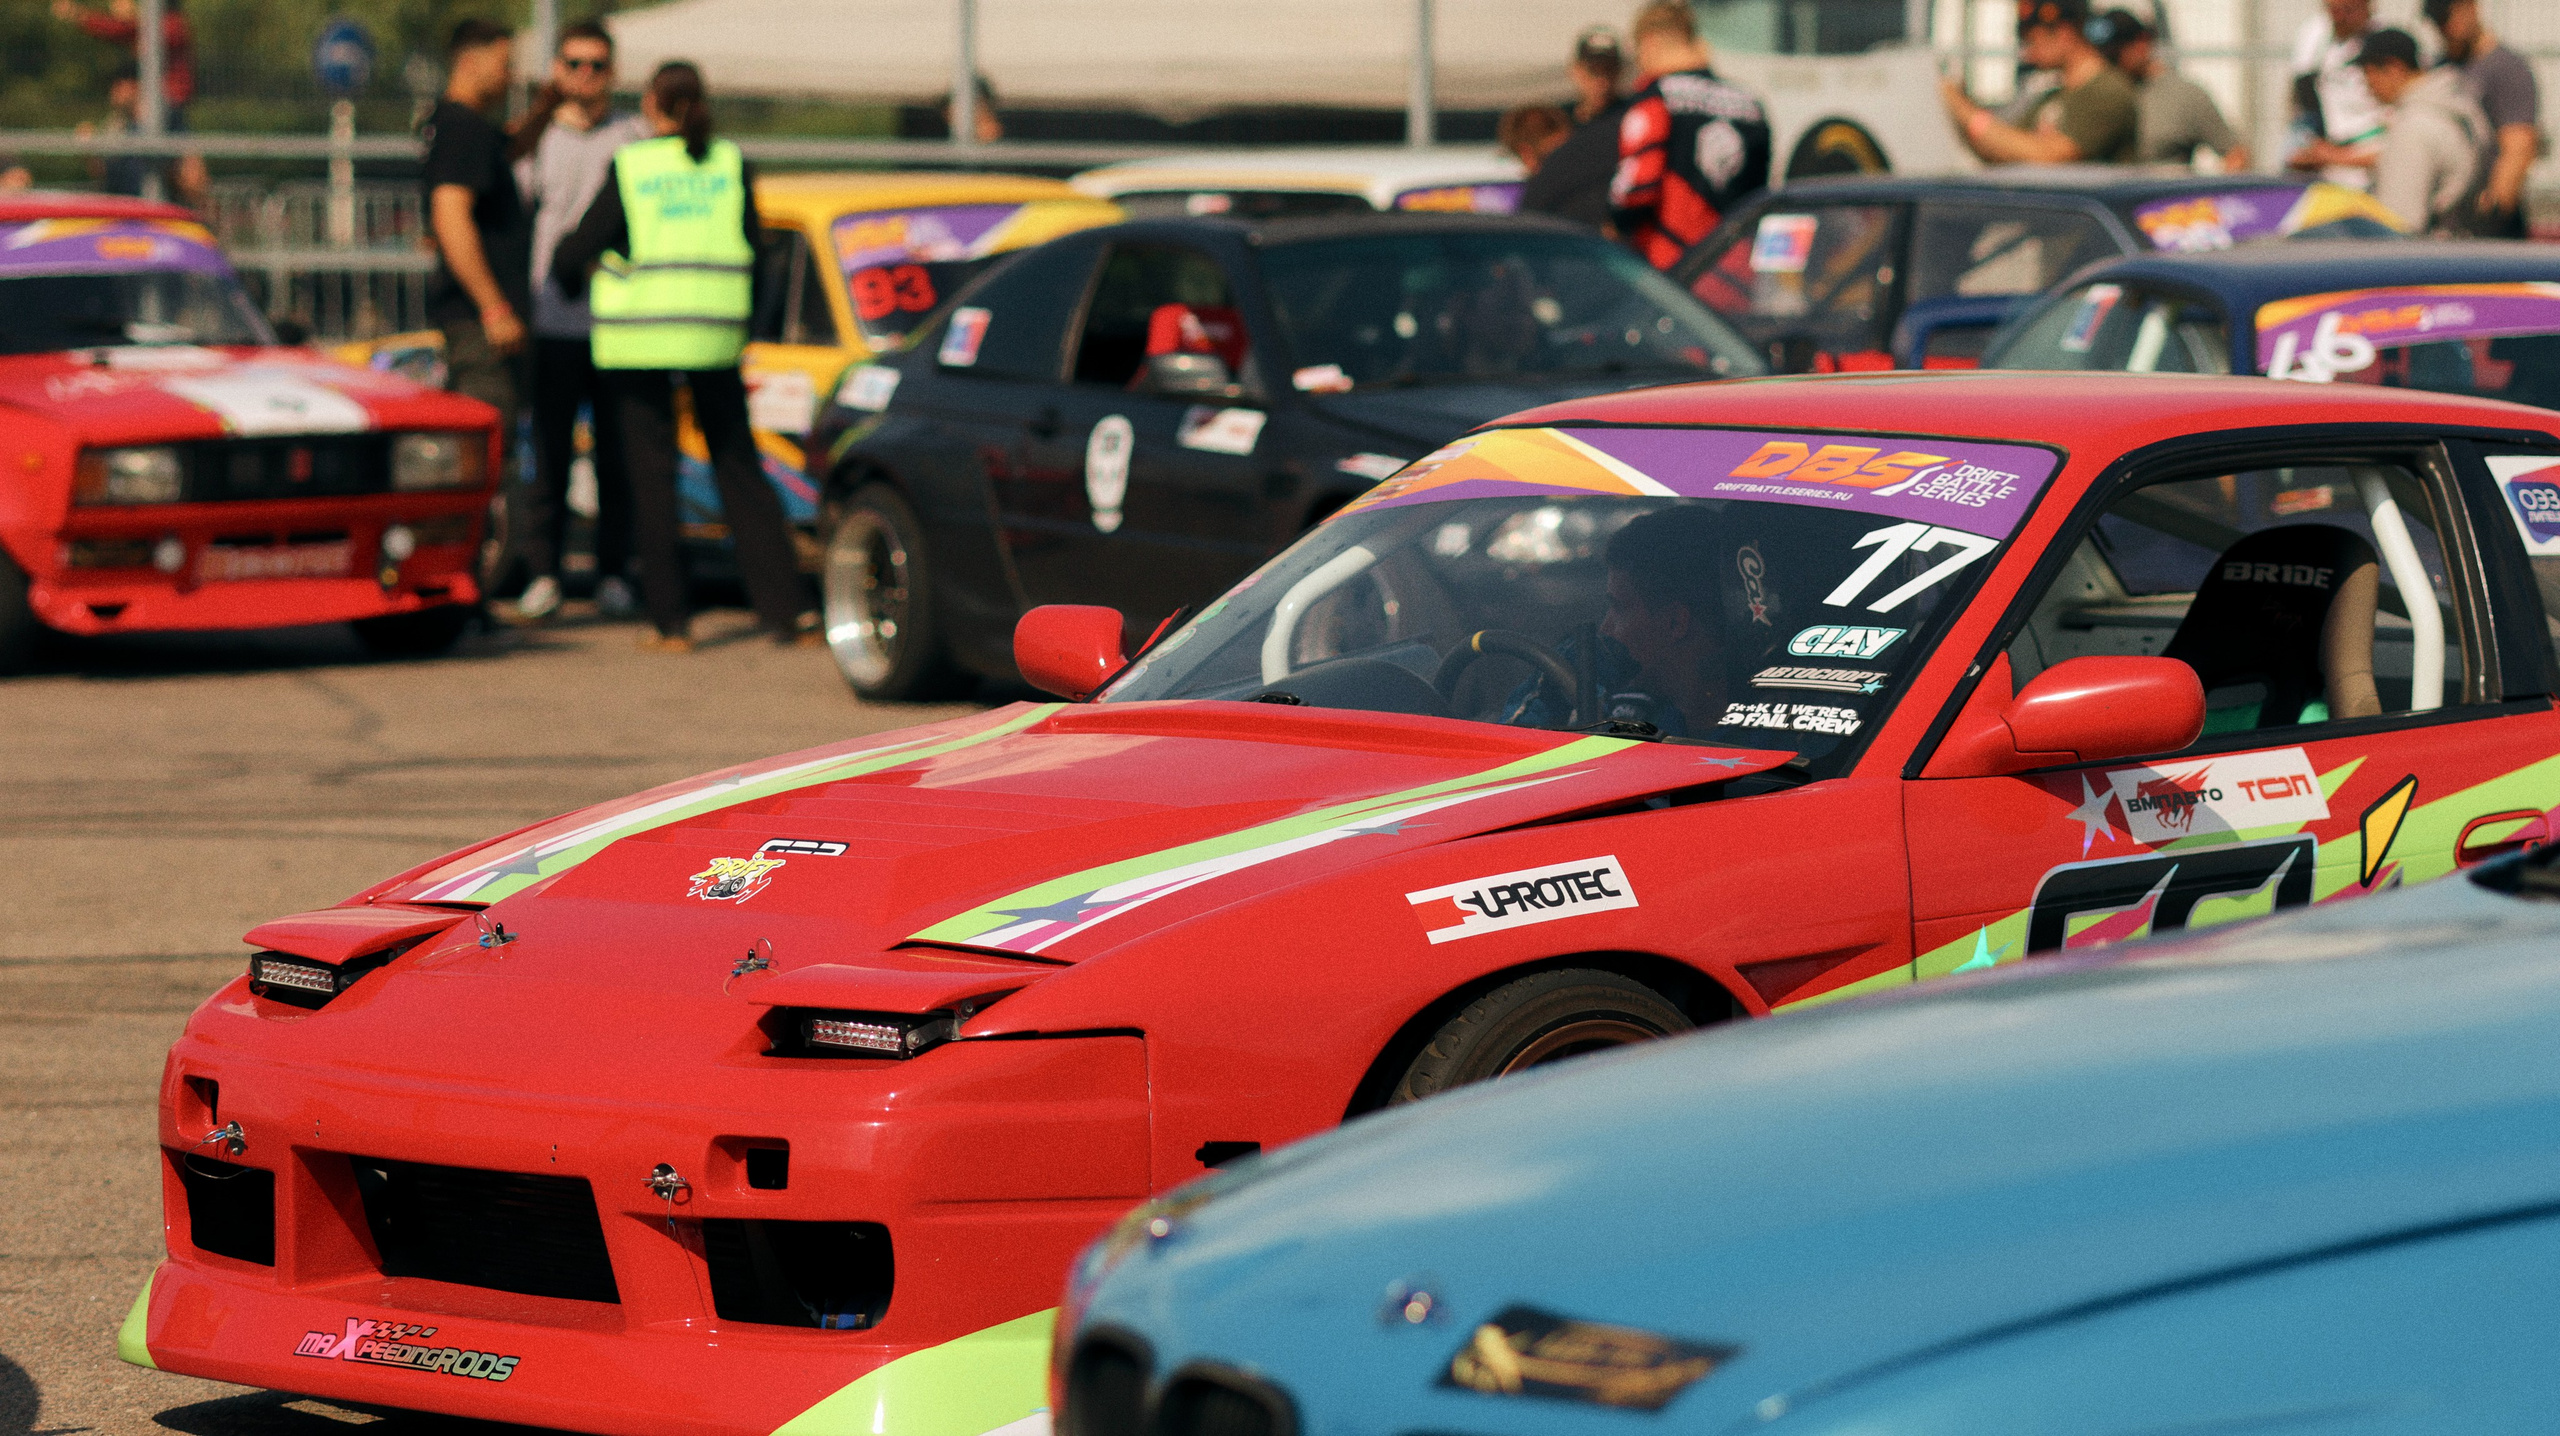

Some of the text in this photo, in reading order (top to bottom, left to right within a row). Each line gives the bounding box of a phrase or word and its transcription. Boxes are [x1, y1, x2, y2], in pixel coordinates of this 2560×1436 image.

[1728, 441, 1950, 489] DBS
[1954, 463, 2020, 484] DRIFT
[1713, 482, 1854, 502] DRIFTBATTLESERIES.RU
[1908, 482, 1992, 508] SERIES
[1932, 472, 2017, 500] BATTLE
[1821, 521, 2000, 613] 17
[2223, 561, 2334, 589] BRIDE
[1753, 667, 1888, 684] АВТОСПОРТ
[1772, 703, 1788, 714] U
[1790, 704, 1842, 719] WE'RE
[1743, 713, 1862, 735] FAIL CREW
